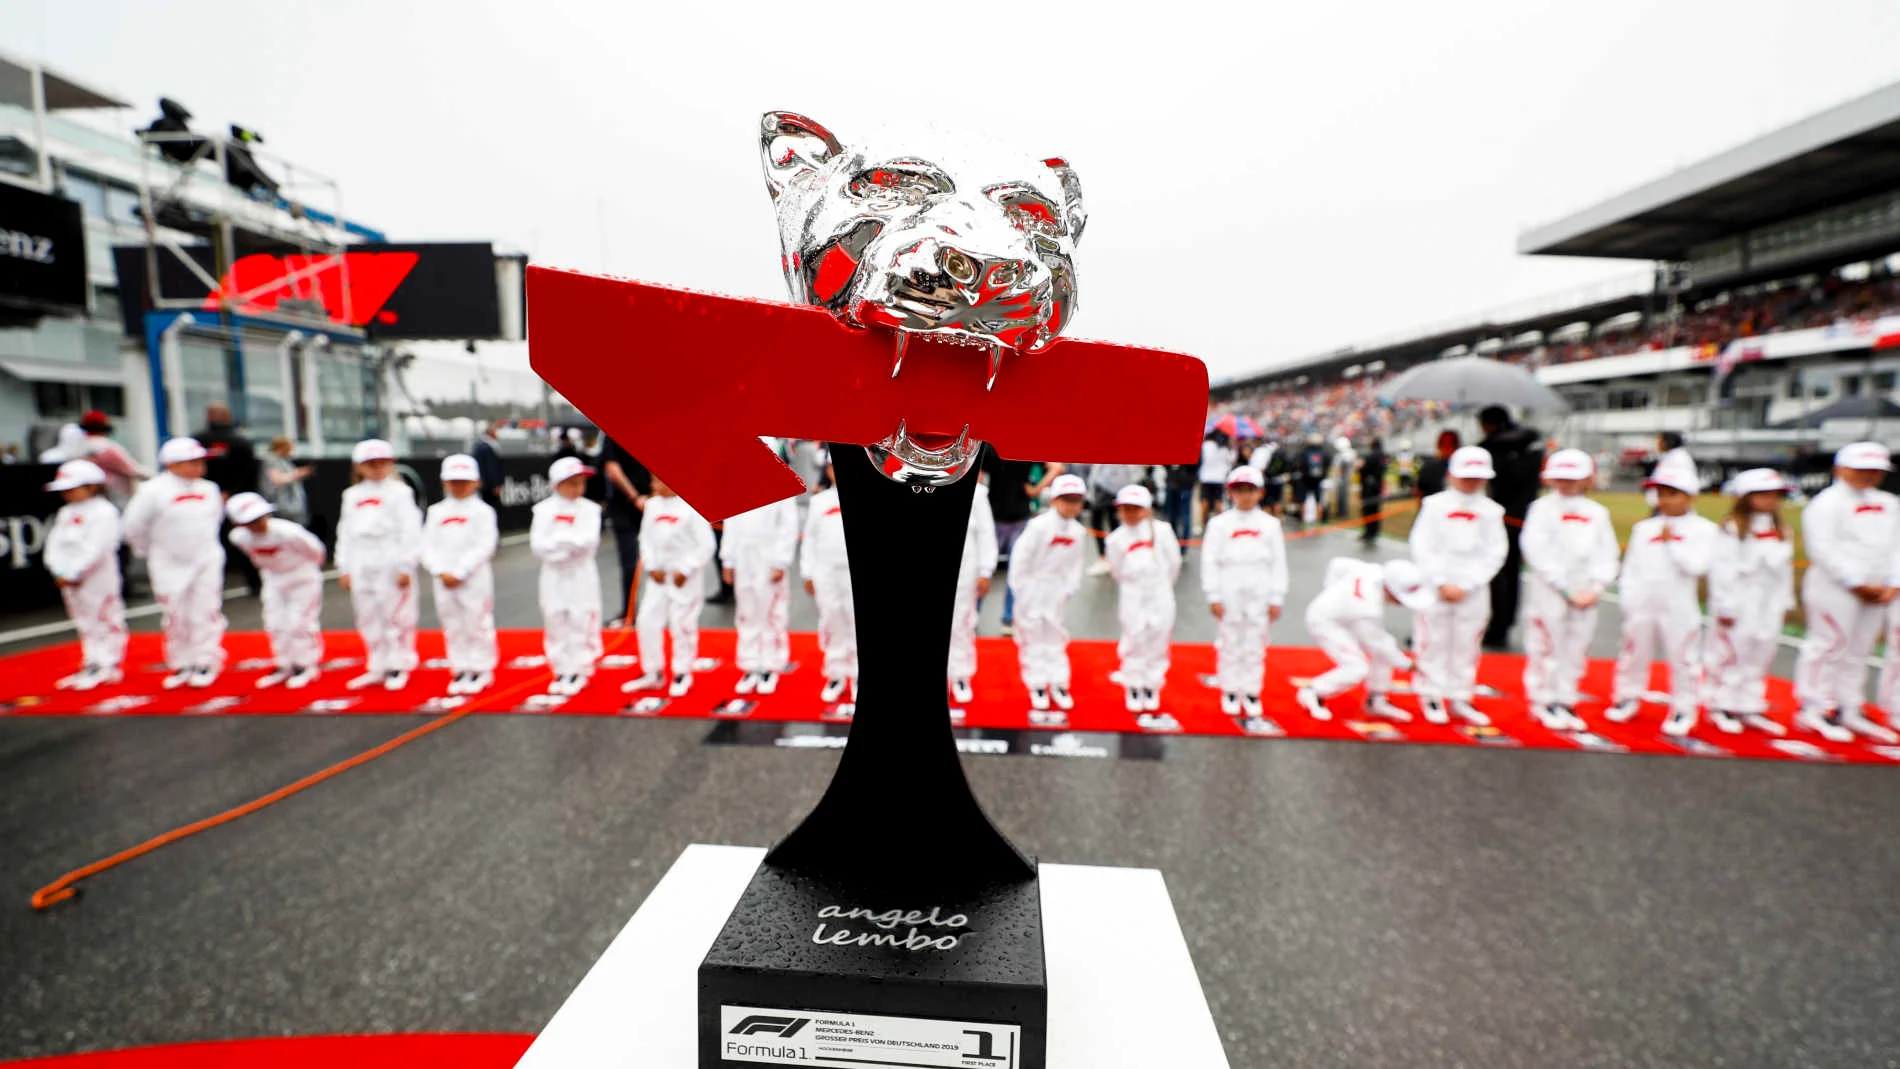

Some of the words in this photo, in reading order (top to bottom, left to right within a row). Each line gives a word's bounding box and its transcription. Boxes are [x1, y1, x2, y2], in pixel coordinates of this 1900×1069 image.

[817, 905, 968, 929] angelo
[812, 923, 958, 950] lembo
[815, 1019, 850, 1027] FORMULA
[815, 1027, 875, 1036] MERCEDES-BENZ
[727, 1042, 796, 1058] Formula
[799, 1047, 808, 1060] 1
[887, 1040, 941, 1049] DEUTSCHLAND
[962, 1030, 1006, 1060] 1
